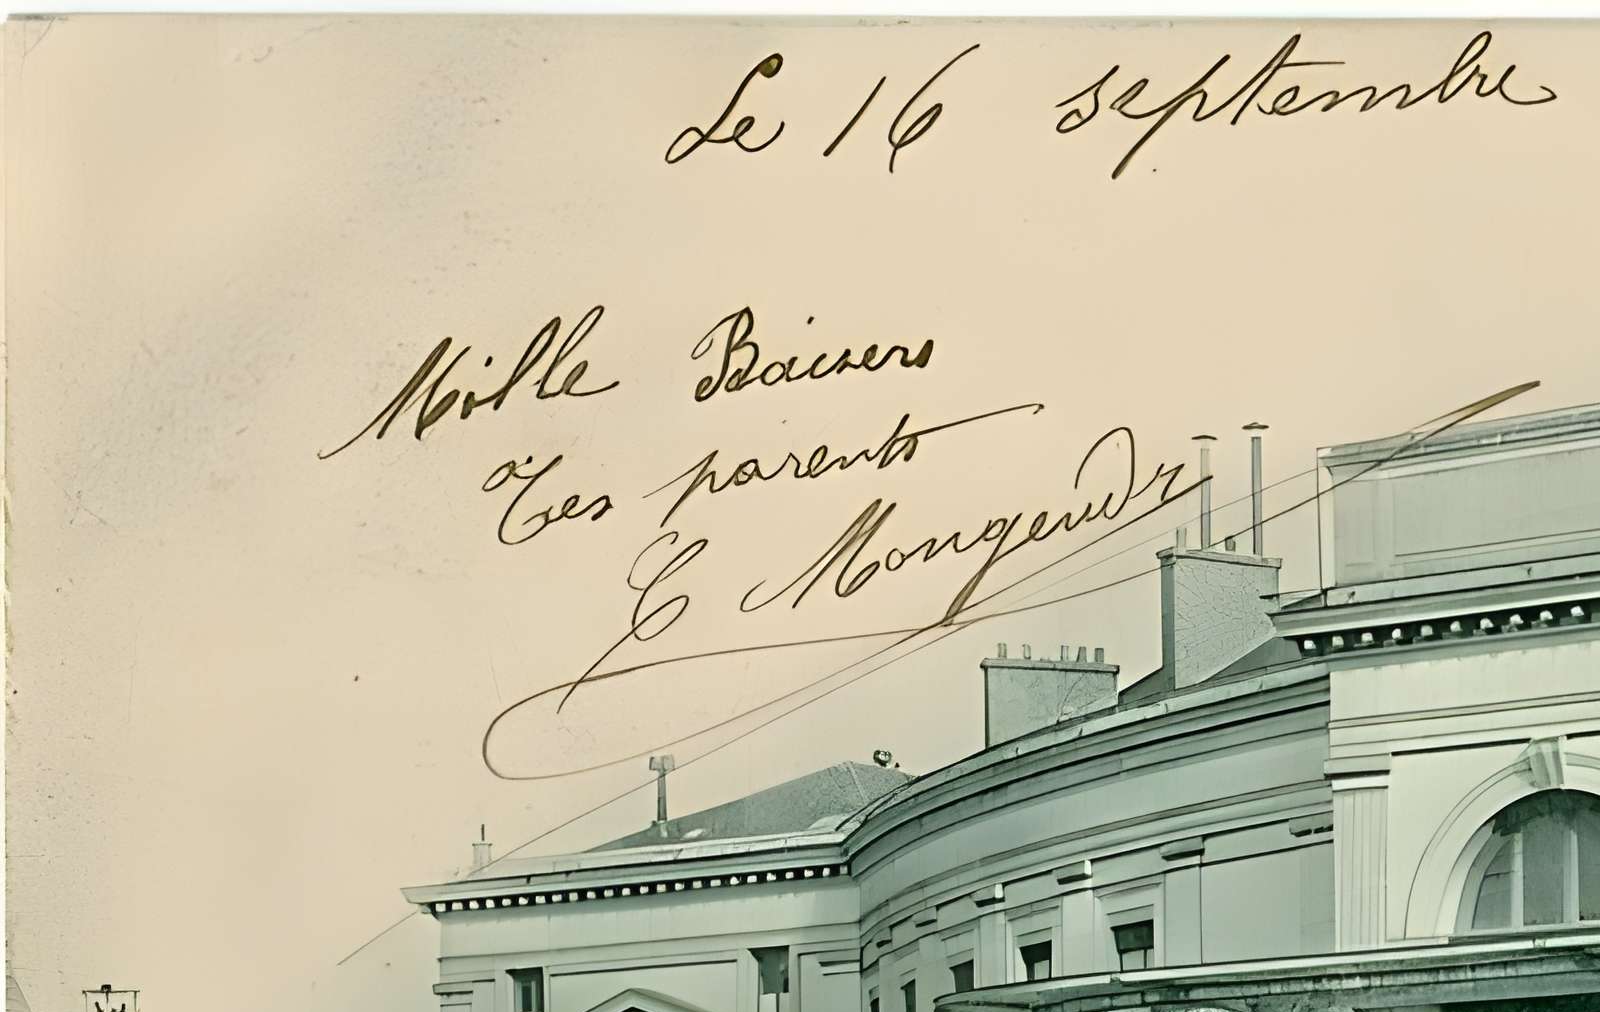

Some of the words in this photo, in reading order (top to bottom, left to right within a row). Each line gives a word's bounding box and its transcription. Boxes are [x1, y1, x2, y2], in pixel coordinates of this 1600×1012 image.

[665, 53, 786, 164] Le
[823, 44, 980, 173] 16
[1056, 31, 1557, 179] septembre
[318, 305, 620, 459] Mille
[691, 306, 934, 403] Baisers
[642, 404, 1044, 528] parents
